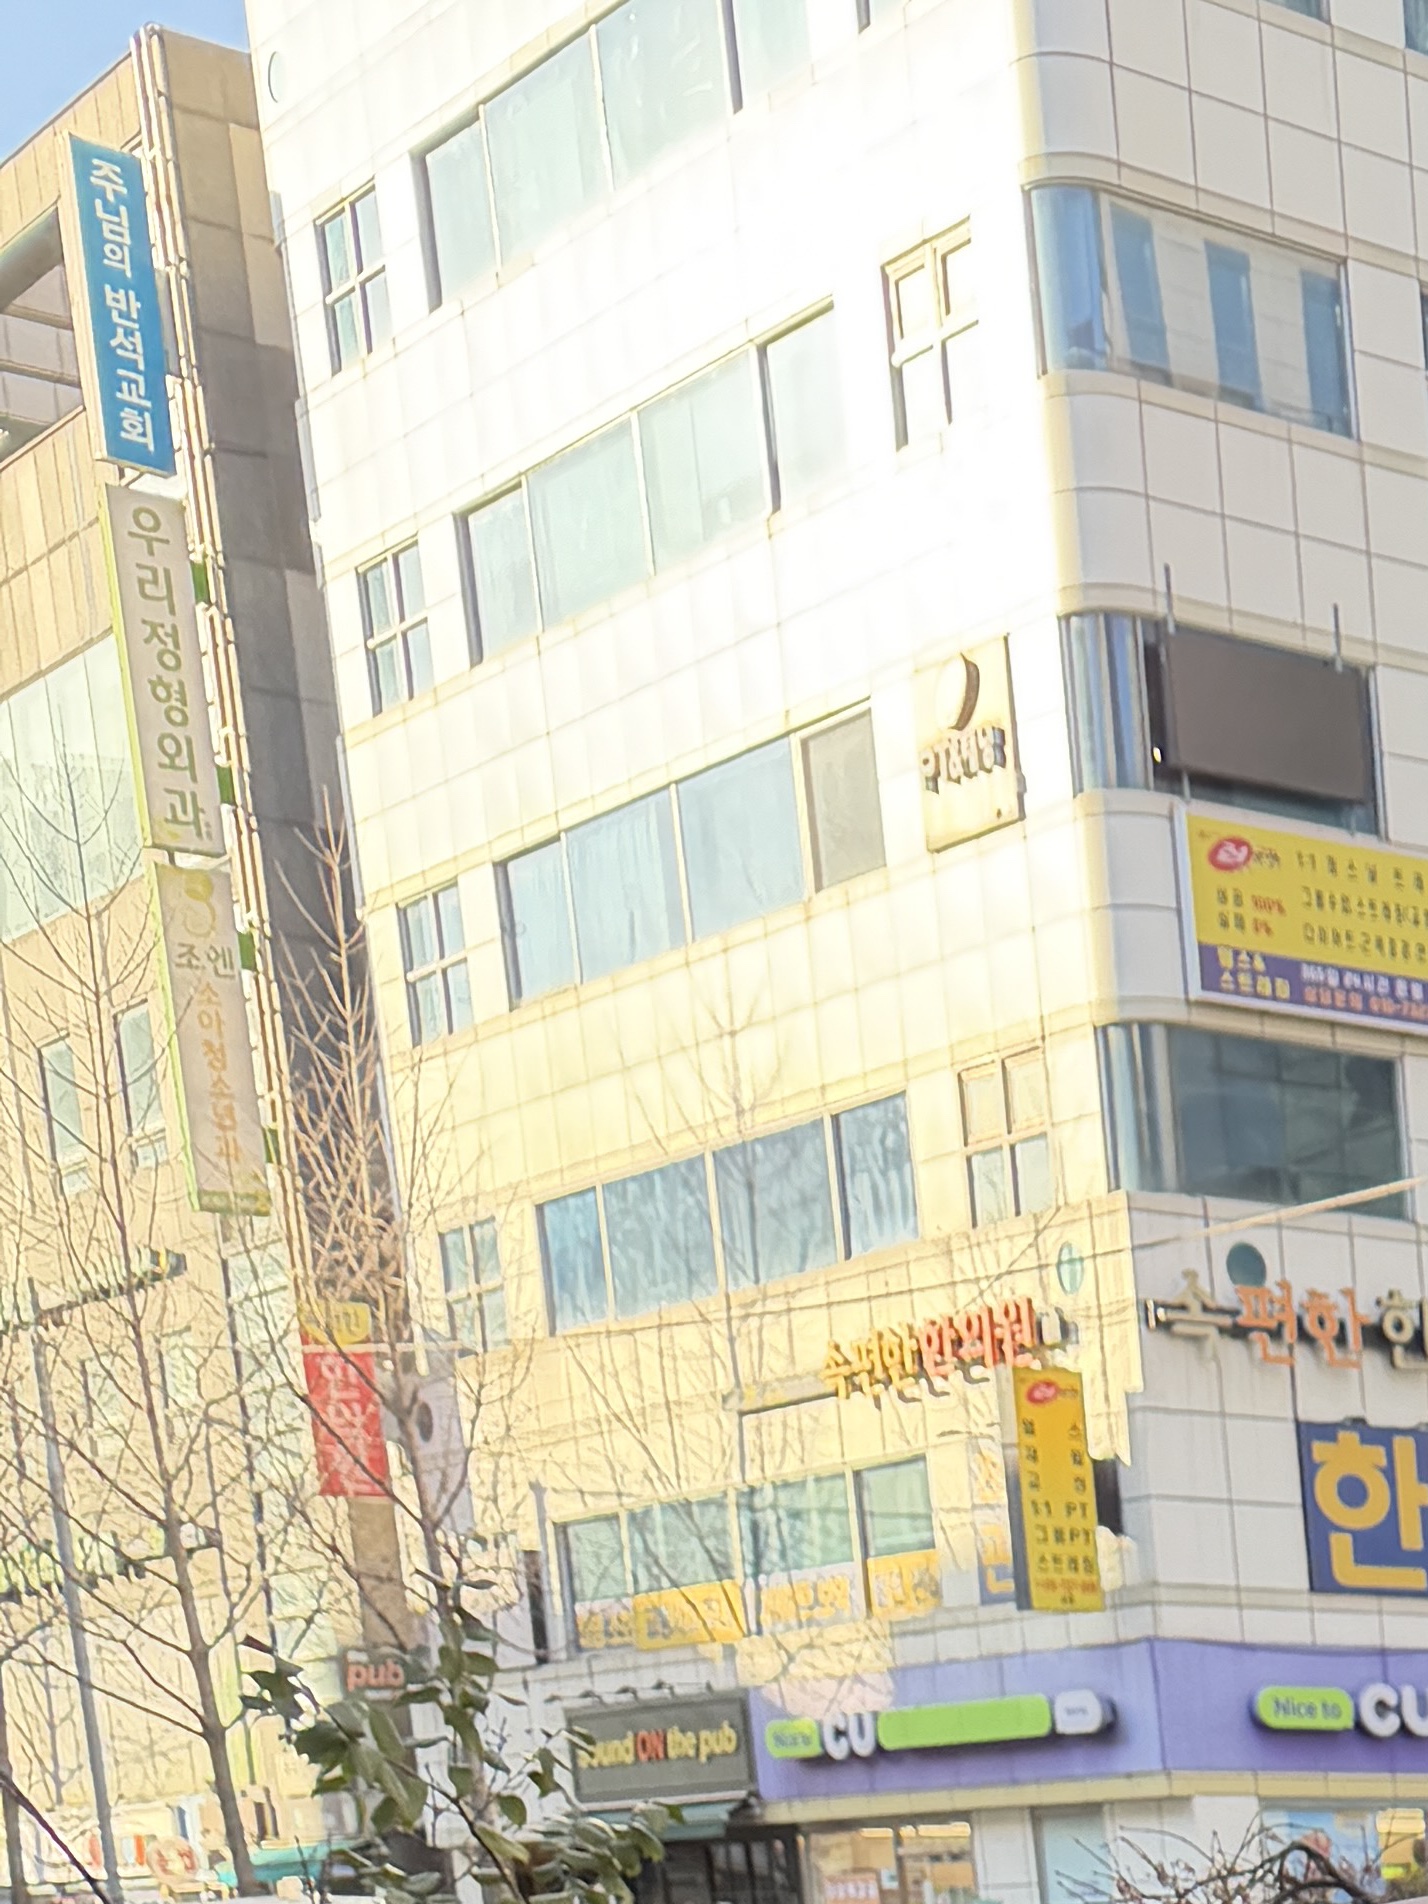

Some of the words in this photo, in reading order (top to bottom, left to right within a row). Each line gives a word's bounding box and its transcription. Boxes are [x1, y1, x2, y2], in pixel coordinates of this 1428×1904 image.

[90, 158, 132, 278] 주님의
[103, 283, 155, 453] 반석교회
[127, 506, 203, 841] 우리정형외과
[346, 1658, 405, 1692] pub
[1273, 1697, 1318, 1719] Nice
[637, 1728, 665, 1762] ON
[698, 1720, 738, 1764] pub
[823, 1710, 876, 1760] CU
